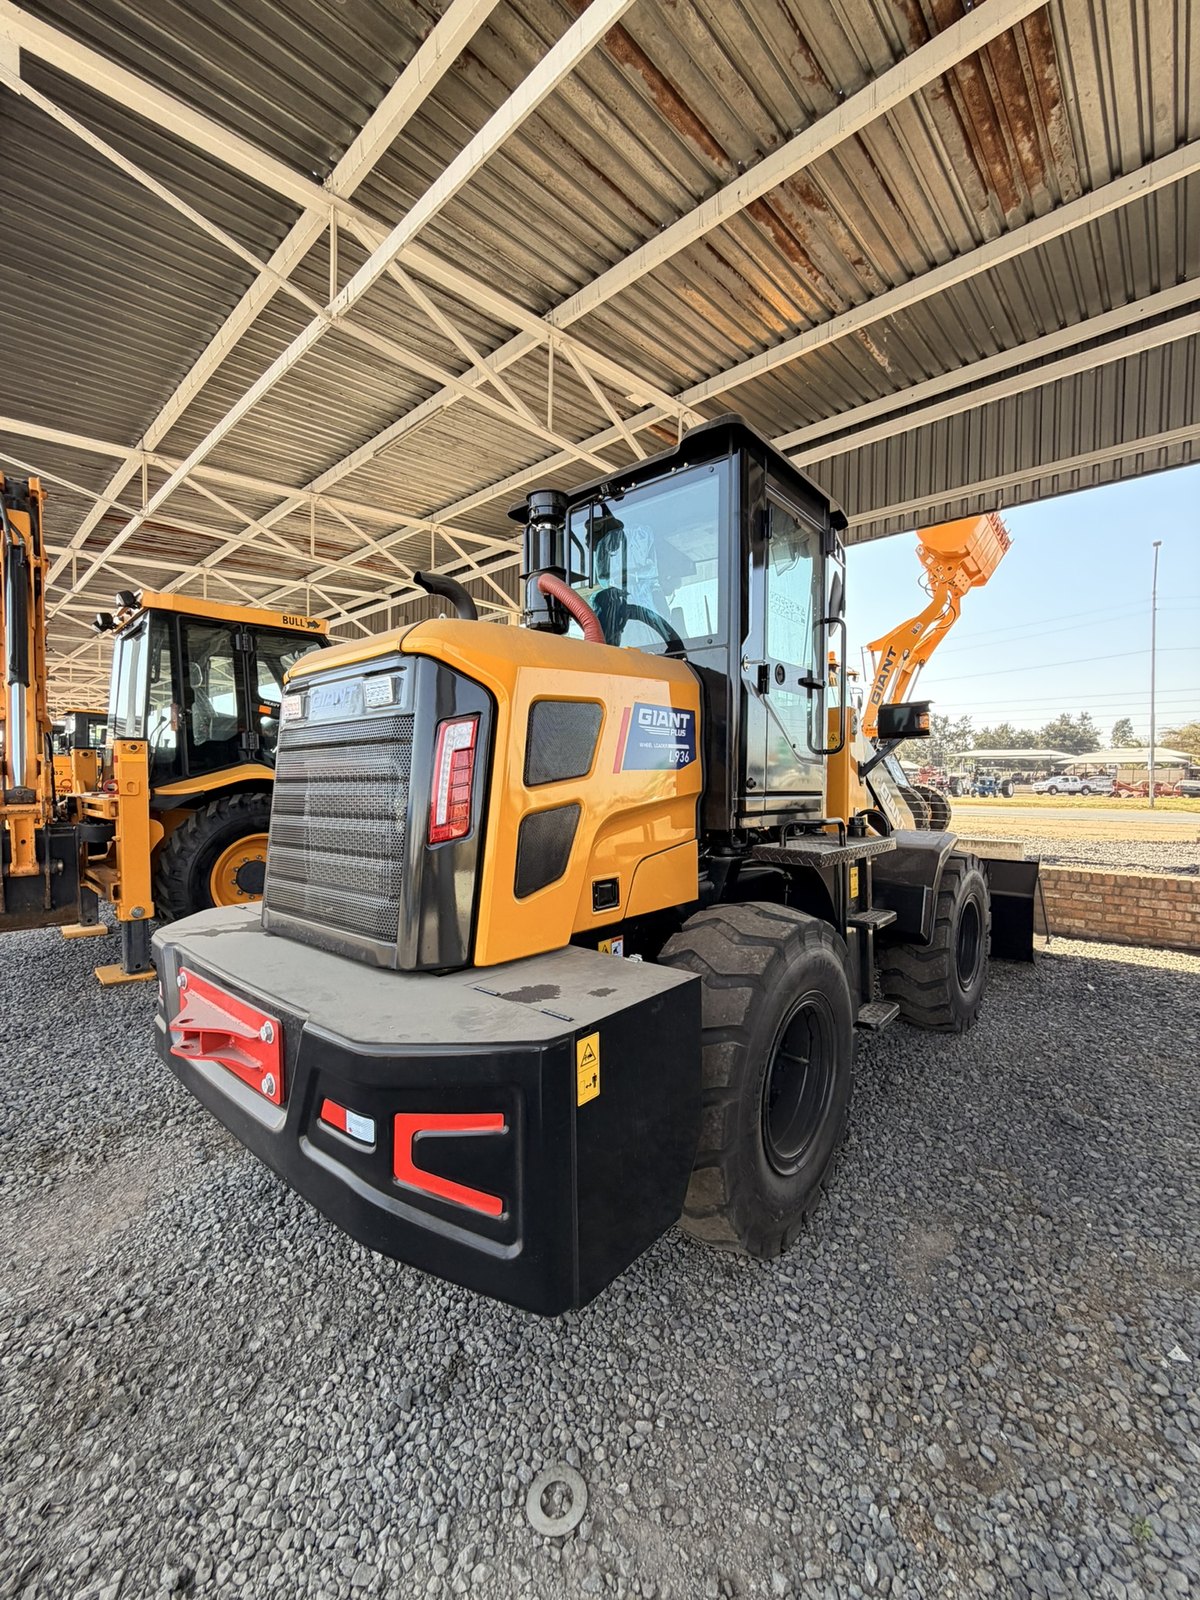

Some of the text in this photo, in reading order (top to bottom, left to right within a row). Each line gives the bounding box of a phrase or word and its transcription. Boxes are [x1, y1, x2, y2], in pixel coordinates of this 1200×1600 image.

[282, 616, 305, 628] BULL
[870, 645, 897, 706] GIANT
[312, 686, 357, 708] GIANT
[638, 708, 690, 729] GIANT
[670, 729, 686, 737] PLUS
[669, 750, 690, 763] L936
